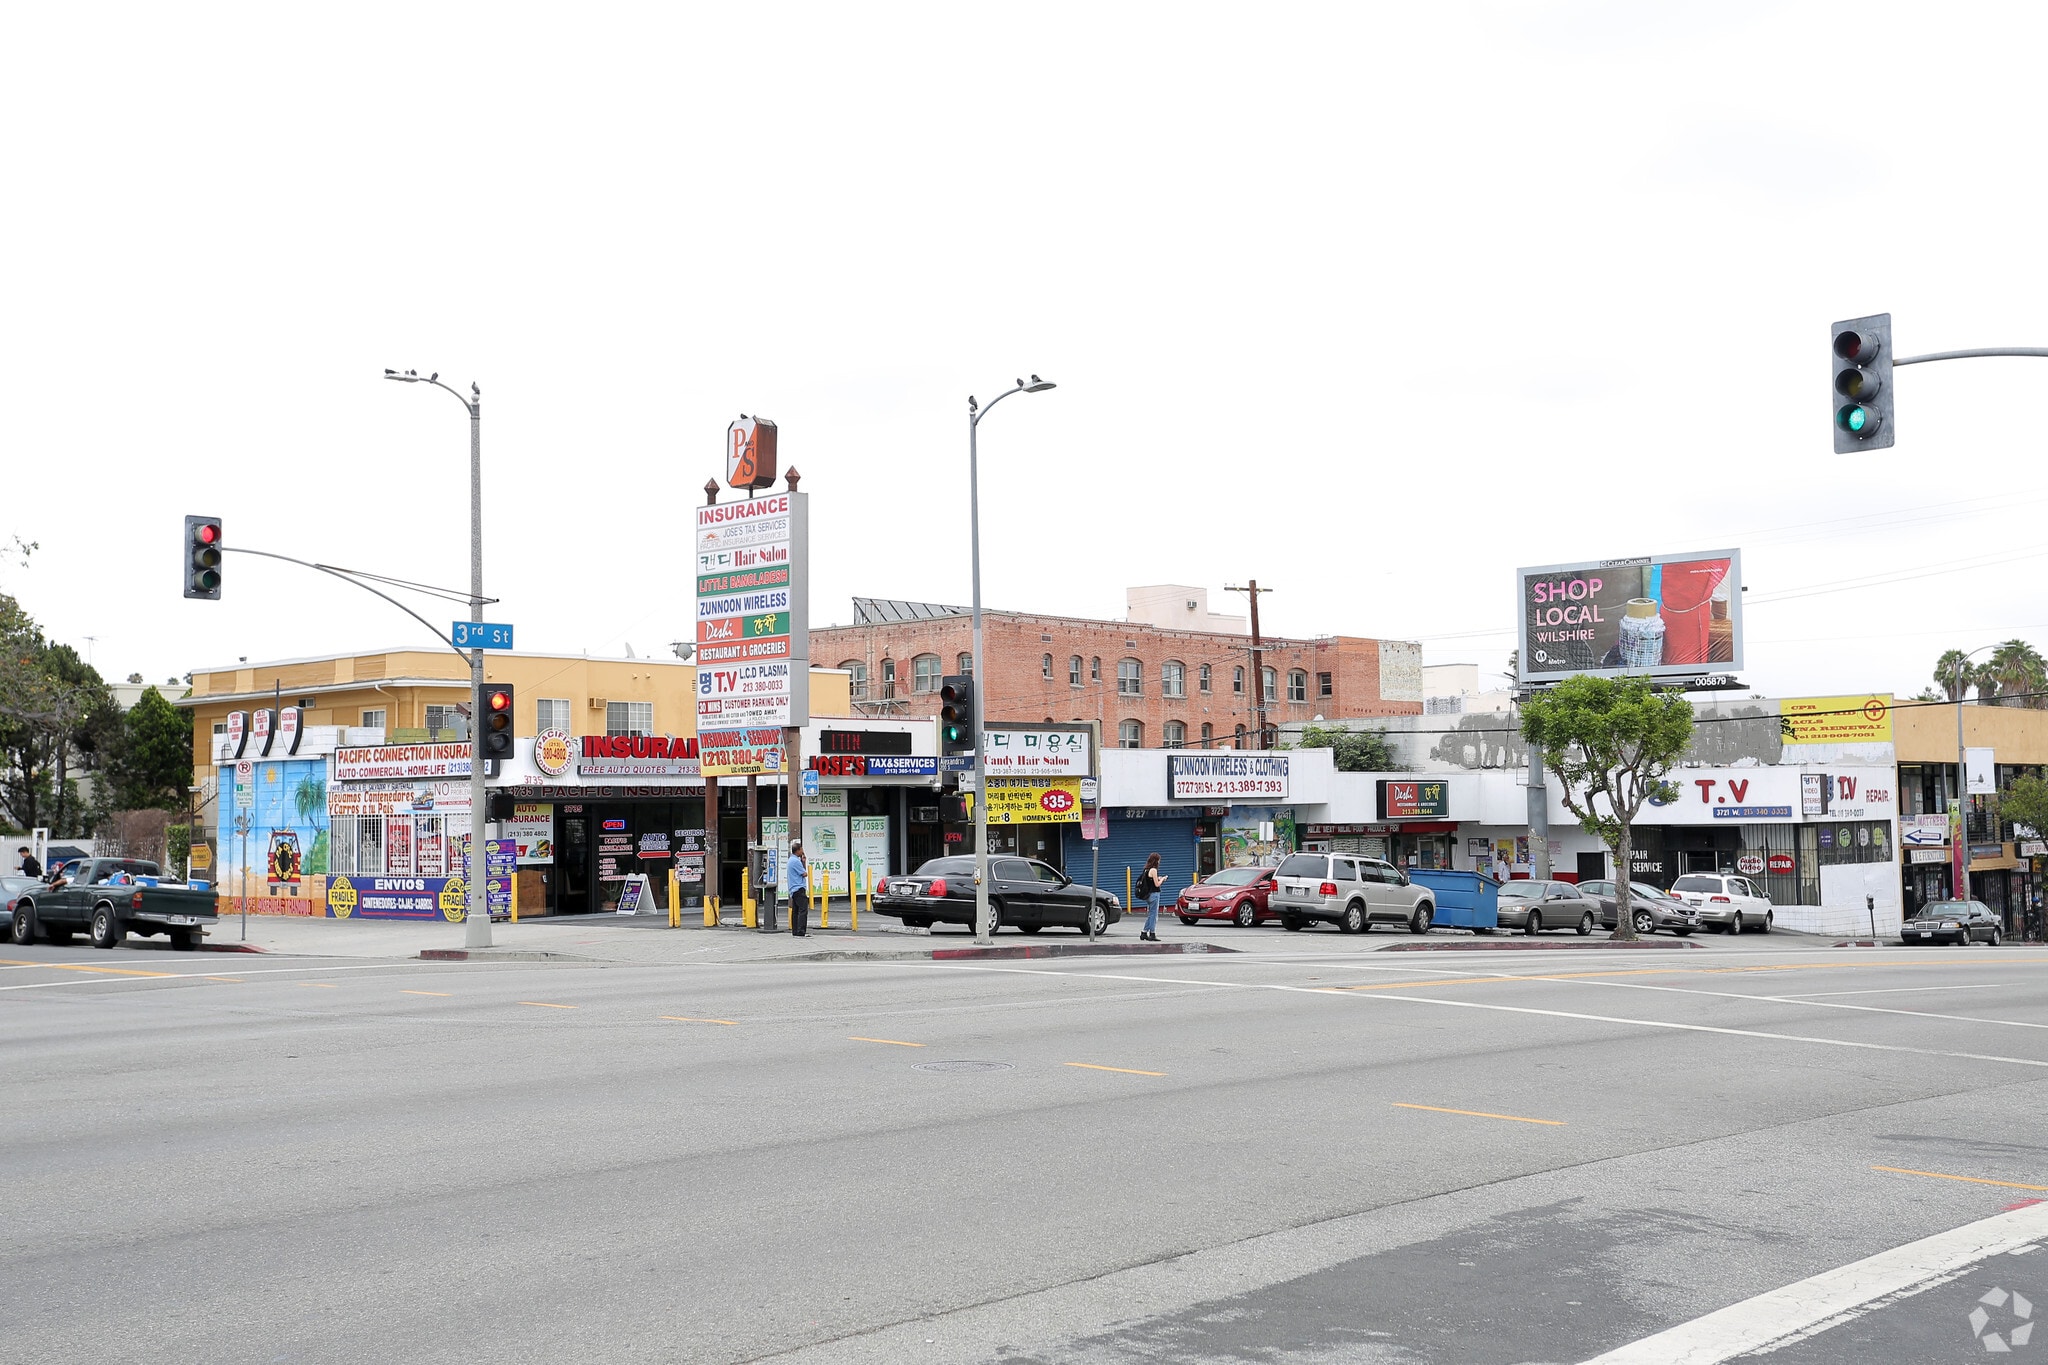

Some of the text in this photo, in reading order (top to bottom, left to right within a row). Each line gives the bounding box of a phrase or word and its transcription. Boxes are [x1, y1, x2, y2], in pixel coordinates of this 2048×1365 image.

[732, 428, 746, 458] P
[742, 448, 755, 477] S
[699, 497, 788, 525] INSURANCE
[723, 519, 787, 538] JOSE'S TAX SERVICES
[722, 536, 756, 546] INSURANCE
[734, 546, 787, 567] Hair Salon
[699, 569, 788, 593] LITTLE BANGLADESH
[1533, 577, 1603, 604] SHOP
[700, 592, 787, 616] ZUNNOON WIRELESS
[1535, 604, 1605, 627] LOCAL
[456, 624, 509, 644] 3rd St
[705, 619, 734, 641] Deshi
[1536, 628, 1595, 643] WILSHIRE
[700, 641, 786, 661] RESTAURANT & GROCERIES
[759, 664, 788, 678] PLASMA
[714, 671, 738, 693] T.V
[743, 680, 784, 693] 213 380-0033
[1695, 677, 1727, 687] 005879
[707, 701, 722, 713] MINS
[724, 696, 789, 710] CUSTOMER PARKING ONLY
[537, 730, 571, 749] PACIFIC
[700, 730, 743, 748] INSURANCE
[1023, 733, 1083, 753] 미용실
[338, 748, 372, 764] PACIFIC
[373, 745, 432, 762] CONNECTION
[701, 750, 731, 767] (213)
[536, 751, 573, 774] CONNECTION
[810, 755, 866, 776] JOSE'S
[869, 758, 935, 768] TAX&SERVICES
[940, 757, 965, 766] Alexandria
[983, 754, 1070, 770] Candy Hair Salon
[1173, 757, 1210, 776] ZUNNOON
[1211, 757, 1248, 776] WIRELESS
[1255, 758, 1289, 777] CLOTHING
[338, 765, 404, 779] AUTO COMMERCIAL
[583, 765, 667, 774] FREE AUTO QUOTES
[523, 775, 544, 785] 3735
[1009, 778, 1051, 787] 여기는 미용실
[1217, 780, 1282, 793] 213-389-7393
[434, 782, 450, 796] NO
[508, 786, 613, 797] 3735 PACIFIC
[1394, 785, 1413, 801] Deshi
[1694, 778, 1749, 804] T.V
[1837, 776, 1857, 800] T.V
[364, 790, 414, 803] Contenedores
[820, 792, 842, 803] Jose's
[1043, 795, 1066, 808] $35
[333, 803, 360, 815] Carros
[516, 805, 538, 813] AUTO
[1126, 810, 1146, 818] 3727
[1210, 807, 1224, 816] 3723
[1716, 809, 1730, 817] 3721
[602, 821, 623, 829] OPEN
[863, 819, 885, 831] Jose's
[988, 815, 1001, 823] CUT
[674, 829, 705, 837] SEGUROS
[1367, 824, 1386, 833] PRODUCE
[604, 837, 628, 845] PACIFIC
[642, 833, 667, 841] AUTO
[944, 833, 962, 842] OPEN
[598, 844, 633, 852] INSURANCE
[681, 843, 699, 851] AUTO
[1632, 862, 1663, 873] SERVICE
[1769, 861, 1792, 869] REPAIR
[374, 879, 425, 891] ENVIOS
[331, 891, 354, 903] FRAGILE
